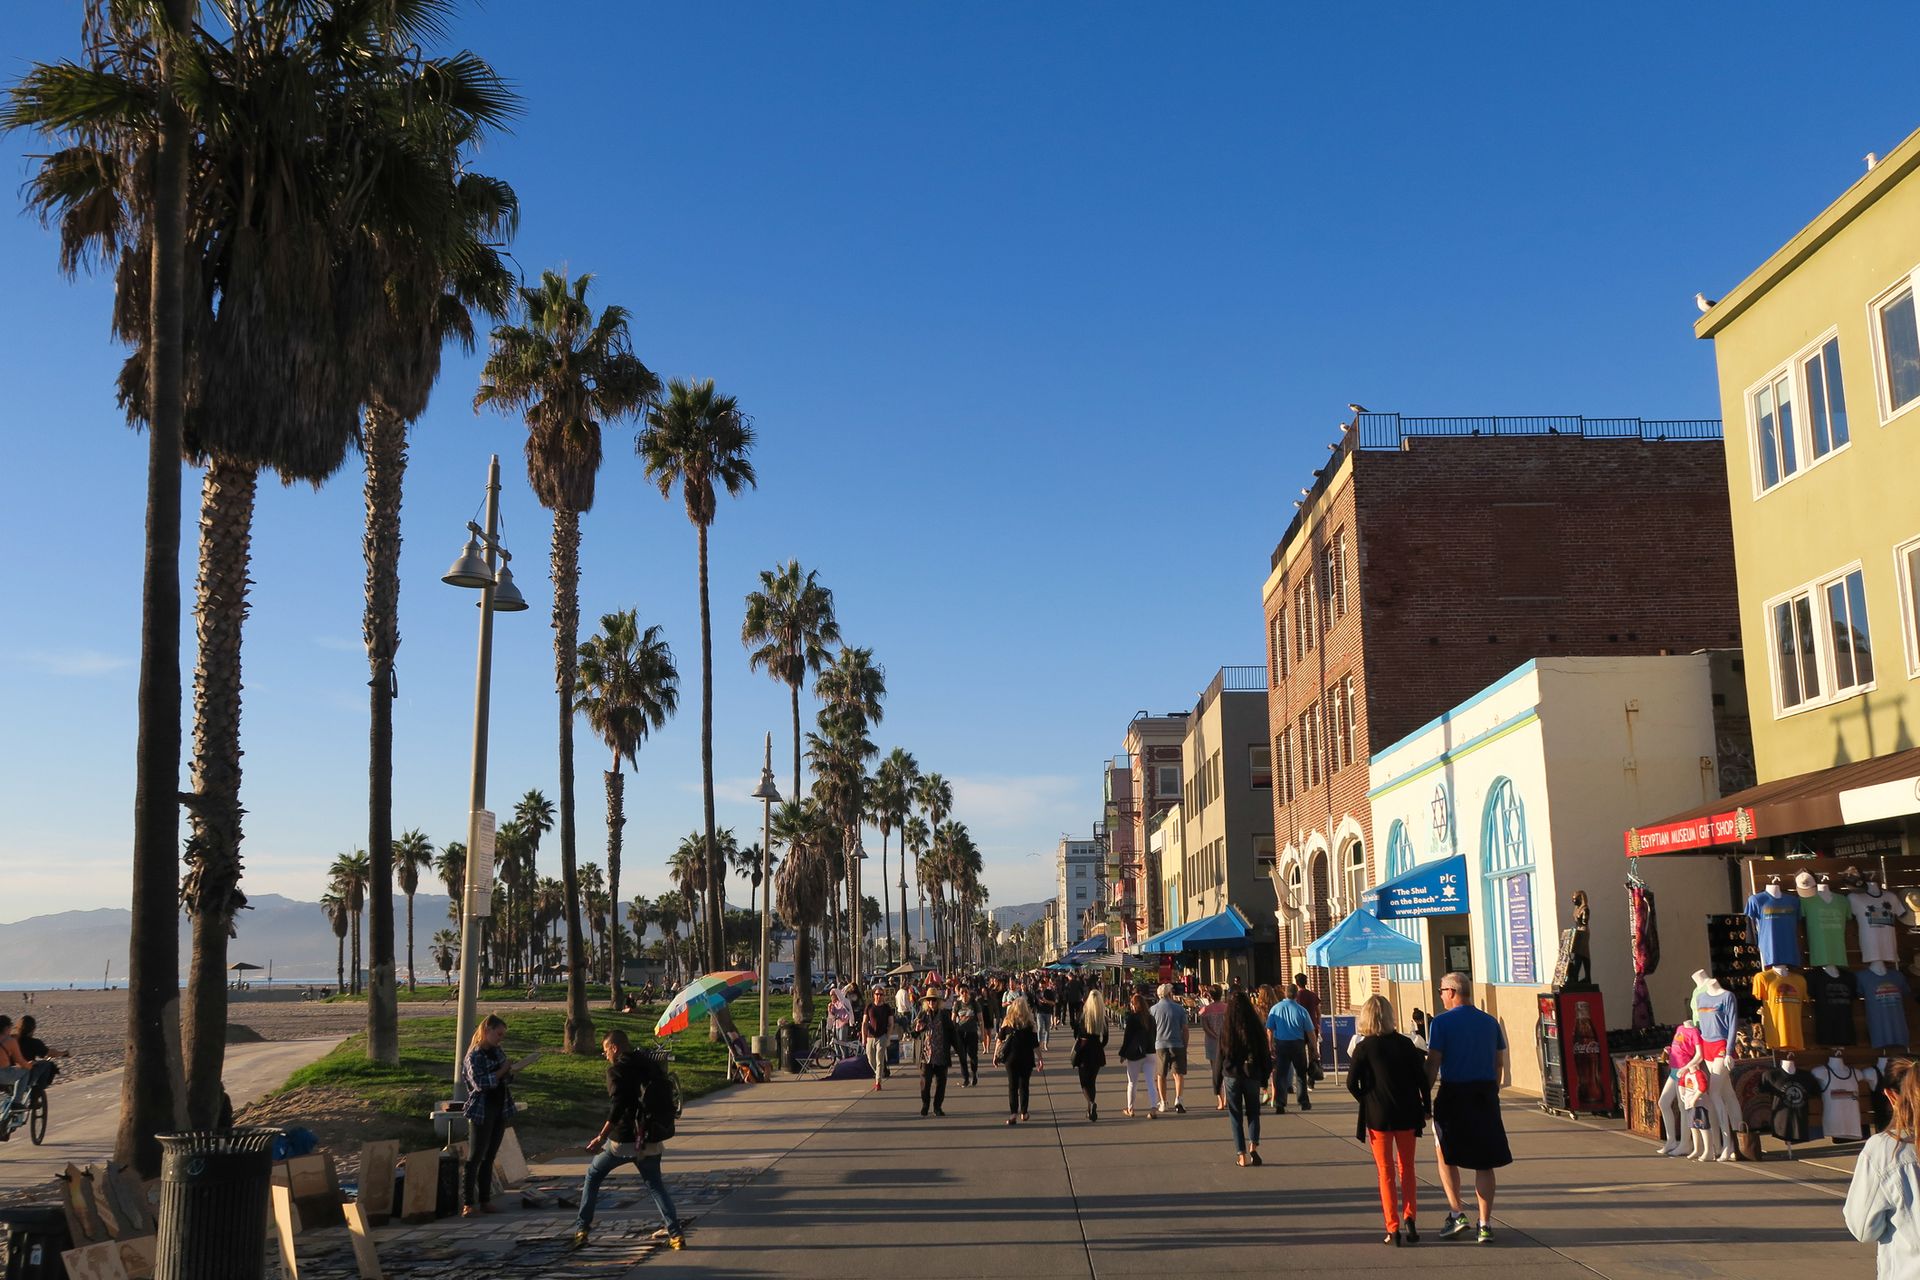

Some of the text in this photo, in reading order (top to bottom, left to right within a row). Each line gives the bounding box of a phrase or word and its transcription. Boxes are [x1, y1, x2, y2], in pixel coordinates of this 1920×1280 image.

[1640, 820, 1734, 848] EGYPTIAN MUSEUM GIFT SHOP
[1440, 874, 1457, 883] PJC
[1411, 886, 1427, 894] Shul
[1395, 905, 1456, 915] www.pjcenter.com
